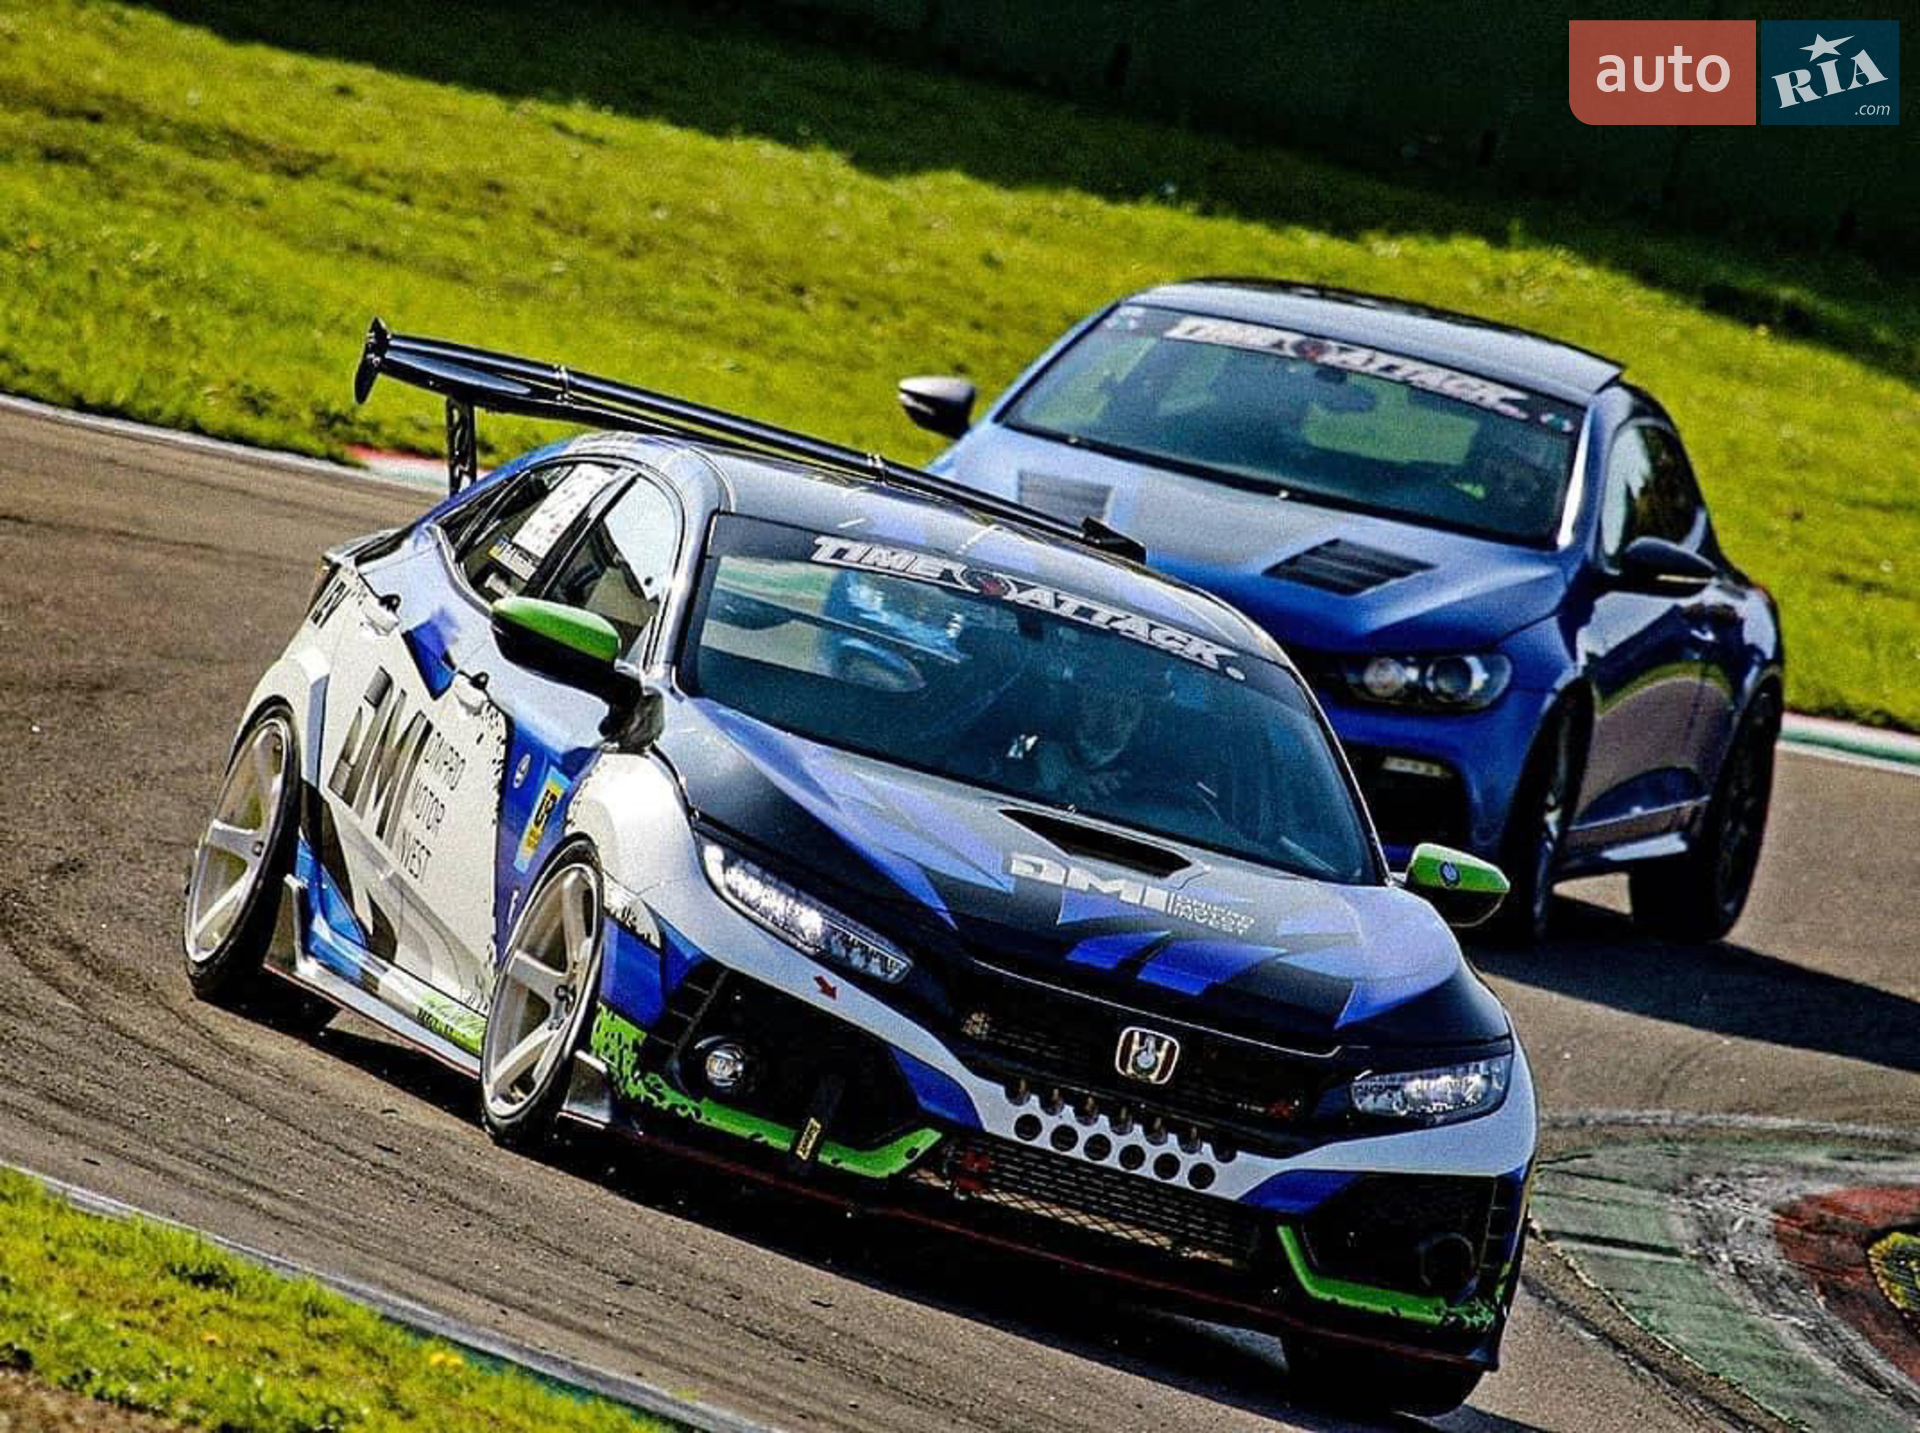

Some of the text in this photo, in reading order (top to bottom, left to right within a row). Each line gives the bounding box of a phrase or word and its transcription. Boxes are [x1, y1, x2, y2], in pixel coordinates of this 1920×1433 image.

[810, 535, 1239, 670] TIME ATTACK
[328, 665, 434, 850] DMI
[1010, 852, 1169, 913] DMI
